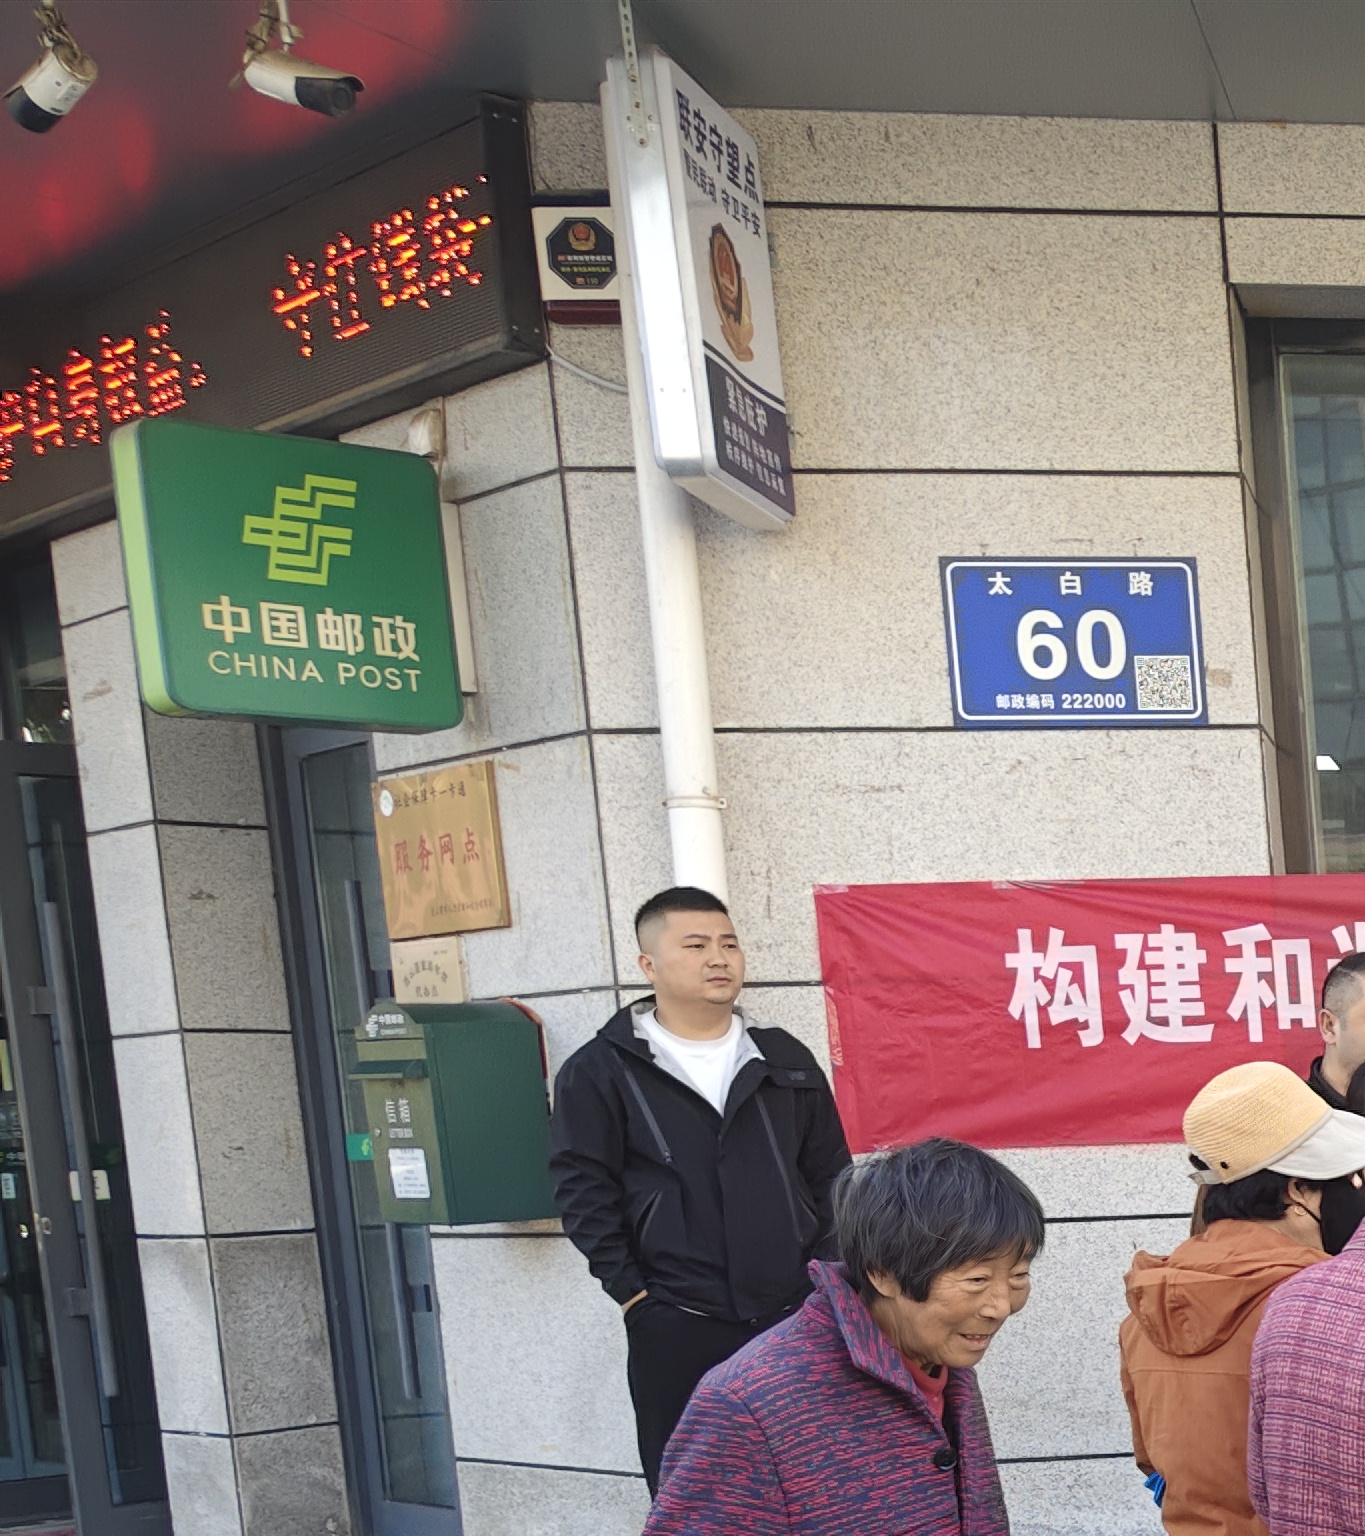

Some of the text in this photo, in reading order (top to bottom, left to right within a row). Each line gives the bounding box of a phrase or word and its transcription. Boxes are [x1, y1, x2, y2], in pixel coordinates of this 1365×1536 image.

[987, 571, 1154, 597] 太白路
[201, 594, 421, 662] 中国邮政
[1016, 609, 1127, 680] 60
[207, 650, 422, 693] CHINA POST
[995, 693, 1127, 710] 邮政编码 222000
[394, 827, 480, 875] 服务网点
